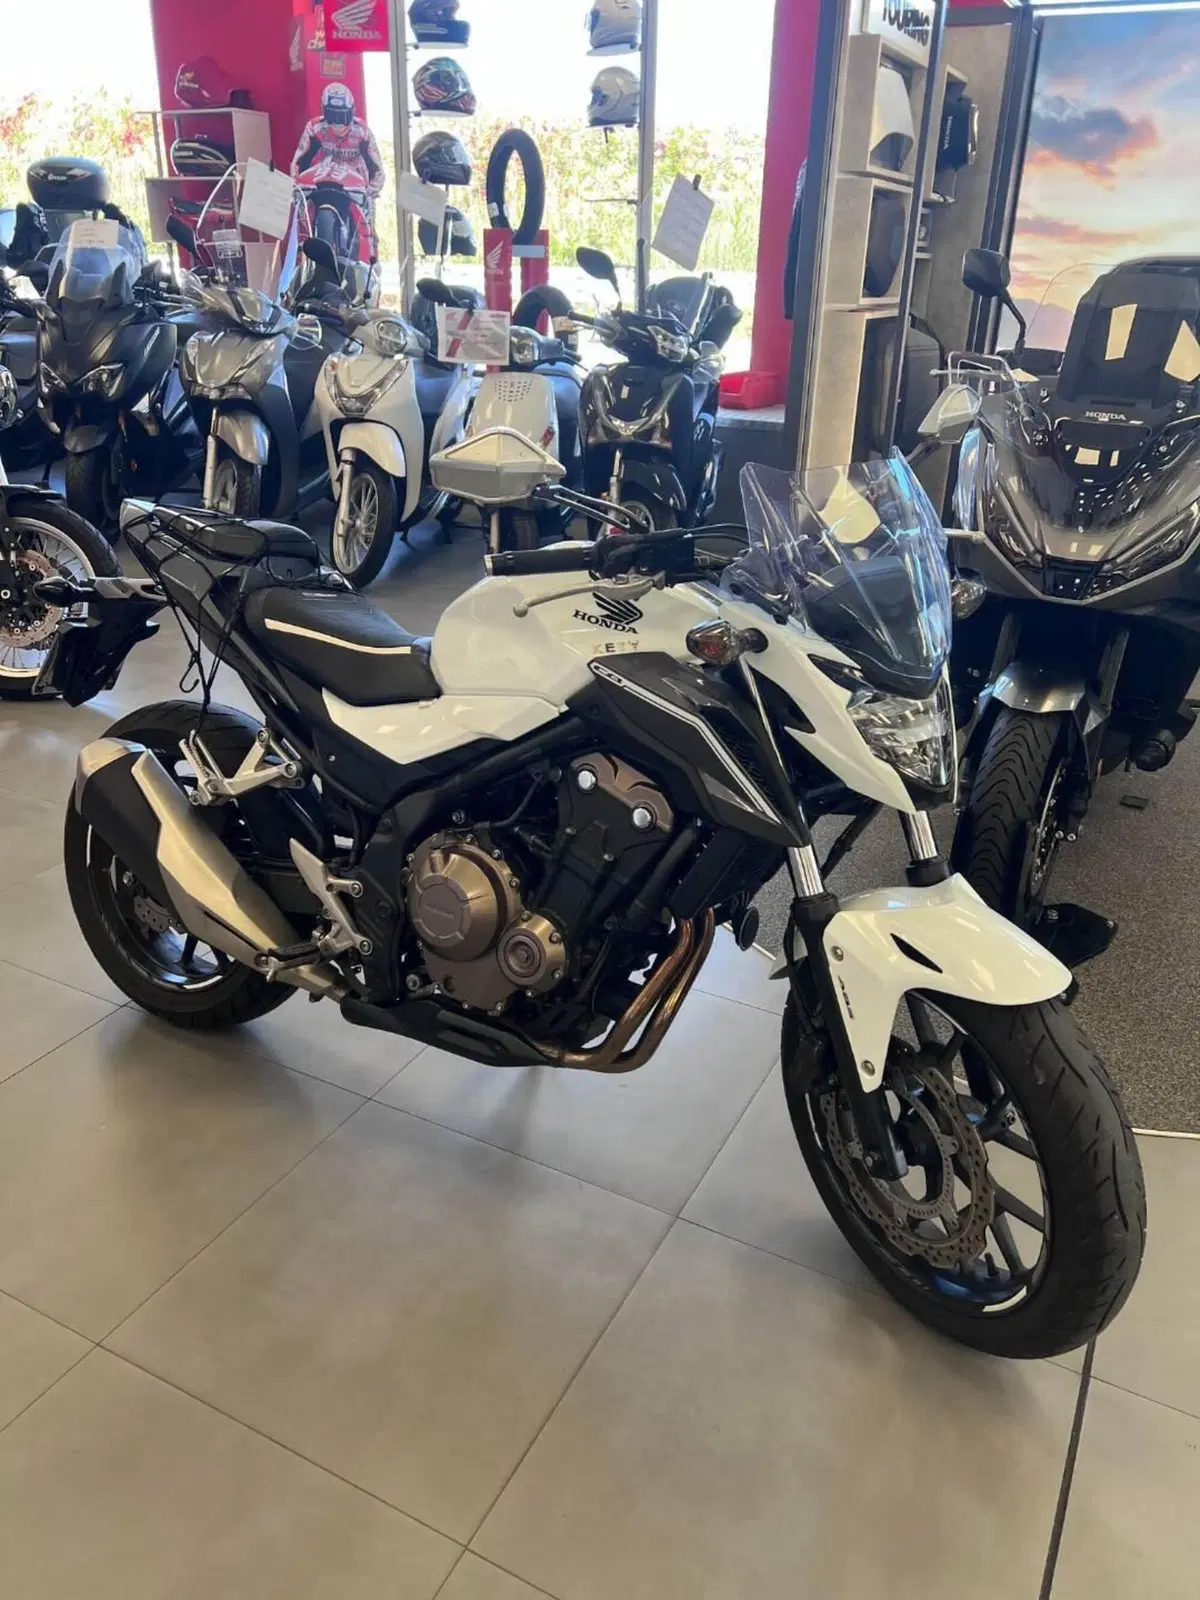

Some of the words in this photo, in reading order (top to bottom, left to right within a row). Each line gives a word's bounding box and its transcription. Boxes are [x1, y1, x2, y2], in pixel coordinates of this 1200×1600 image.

[332, 31, 382, 39] HONDA
[1084, 410, 1127, 420] HONDA
[572, 609, 639, 634] HONDA
[837, 975, 855, 1020] ABS
